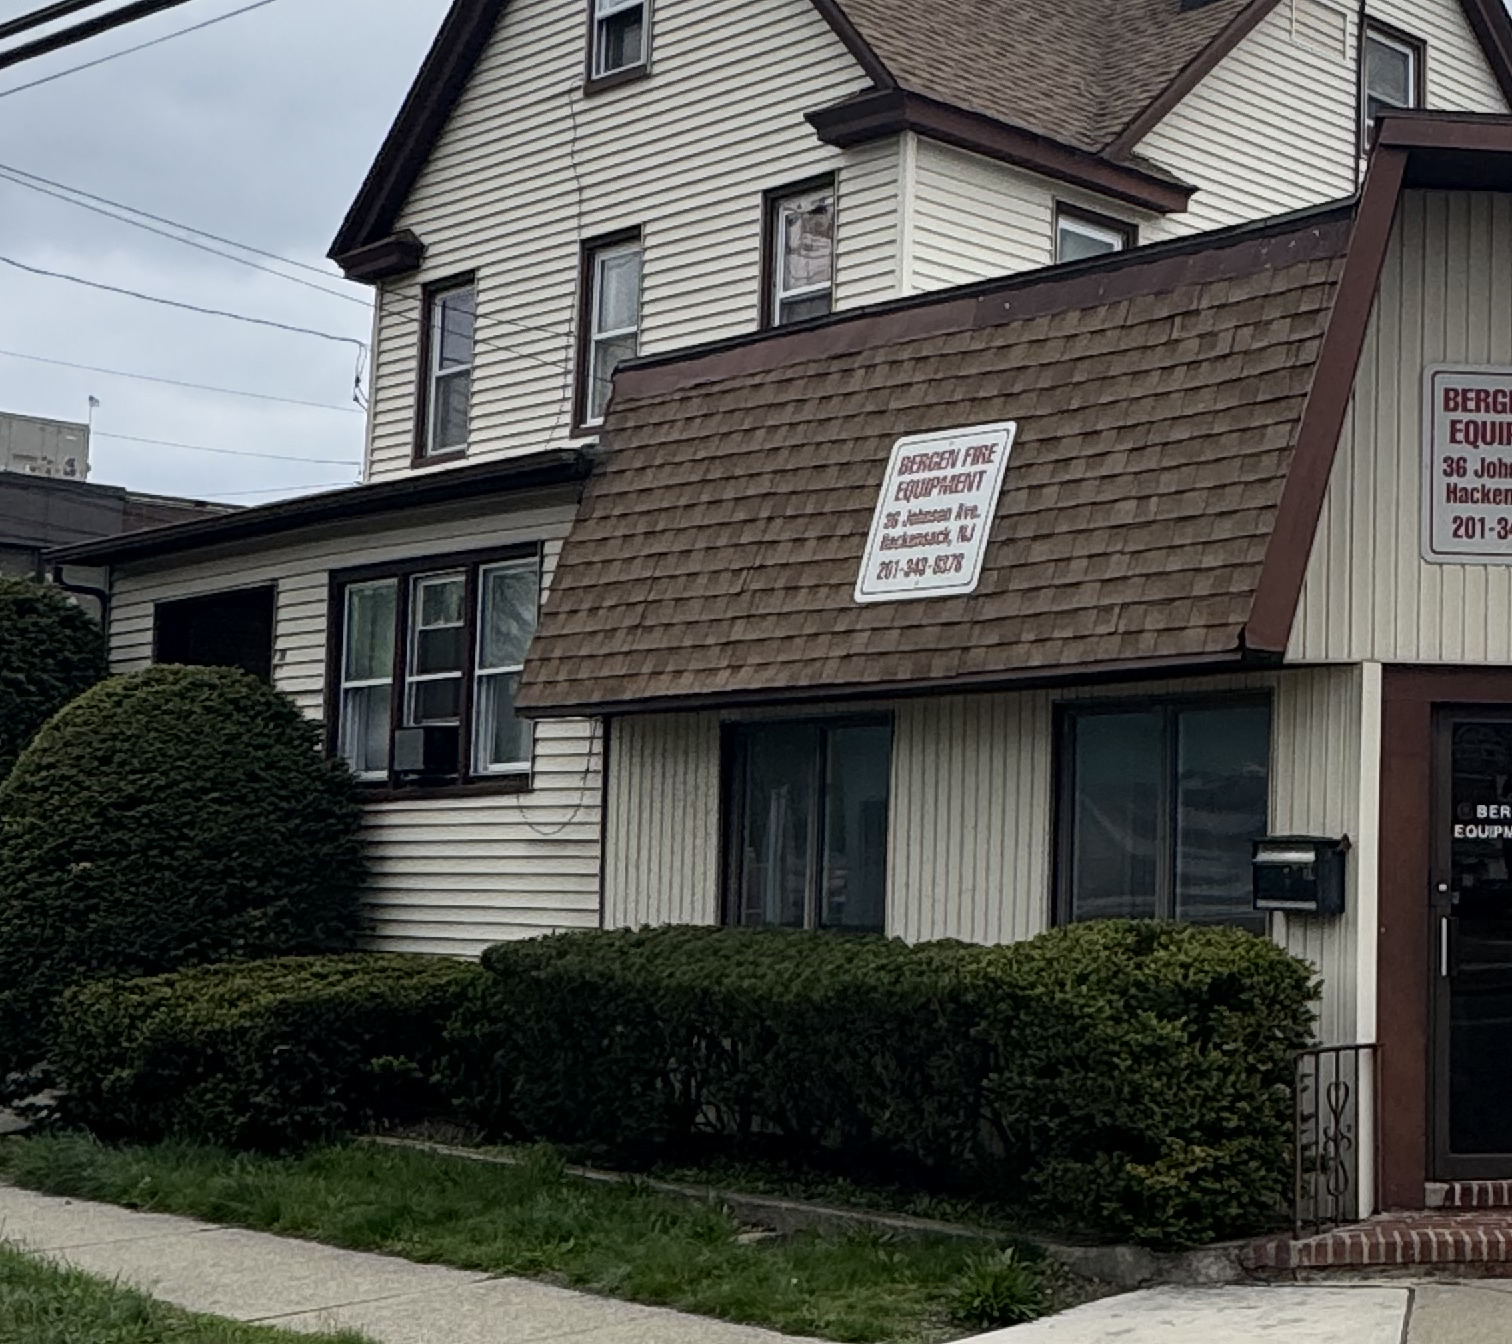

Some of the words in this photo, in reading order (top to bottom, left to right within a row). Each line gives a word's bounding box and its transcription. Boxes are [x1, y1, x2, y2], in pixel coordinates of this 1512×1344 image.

[898, 448, 961, 475] BERGEN
[962, 443, 999, 467] FIRE
[1442, 455, 1468, 478] 36
[894, 470, 987, 503] EQUIPMENT
